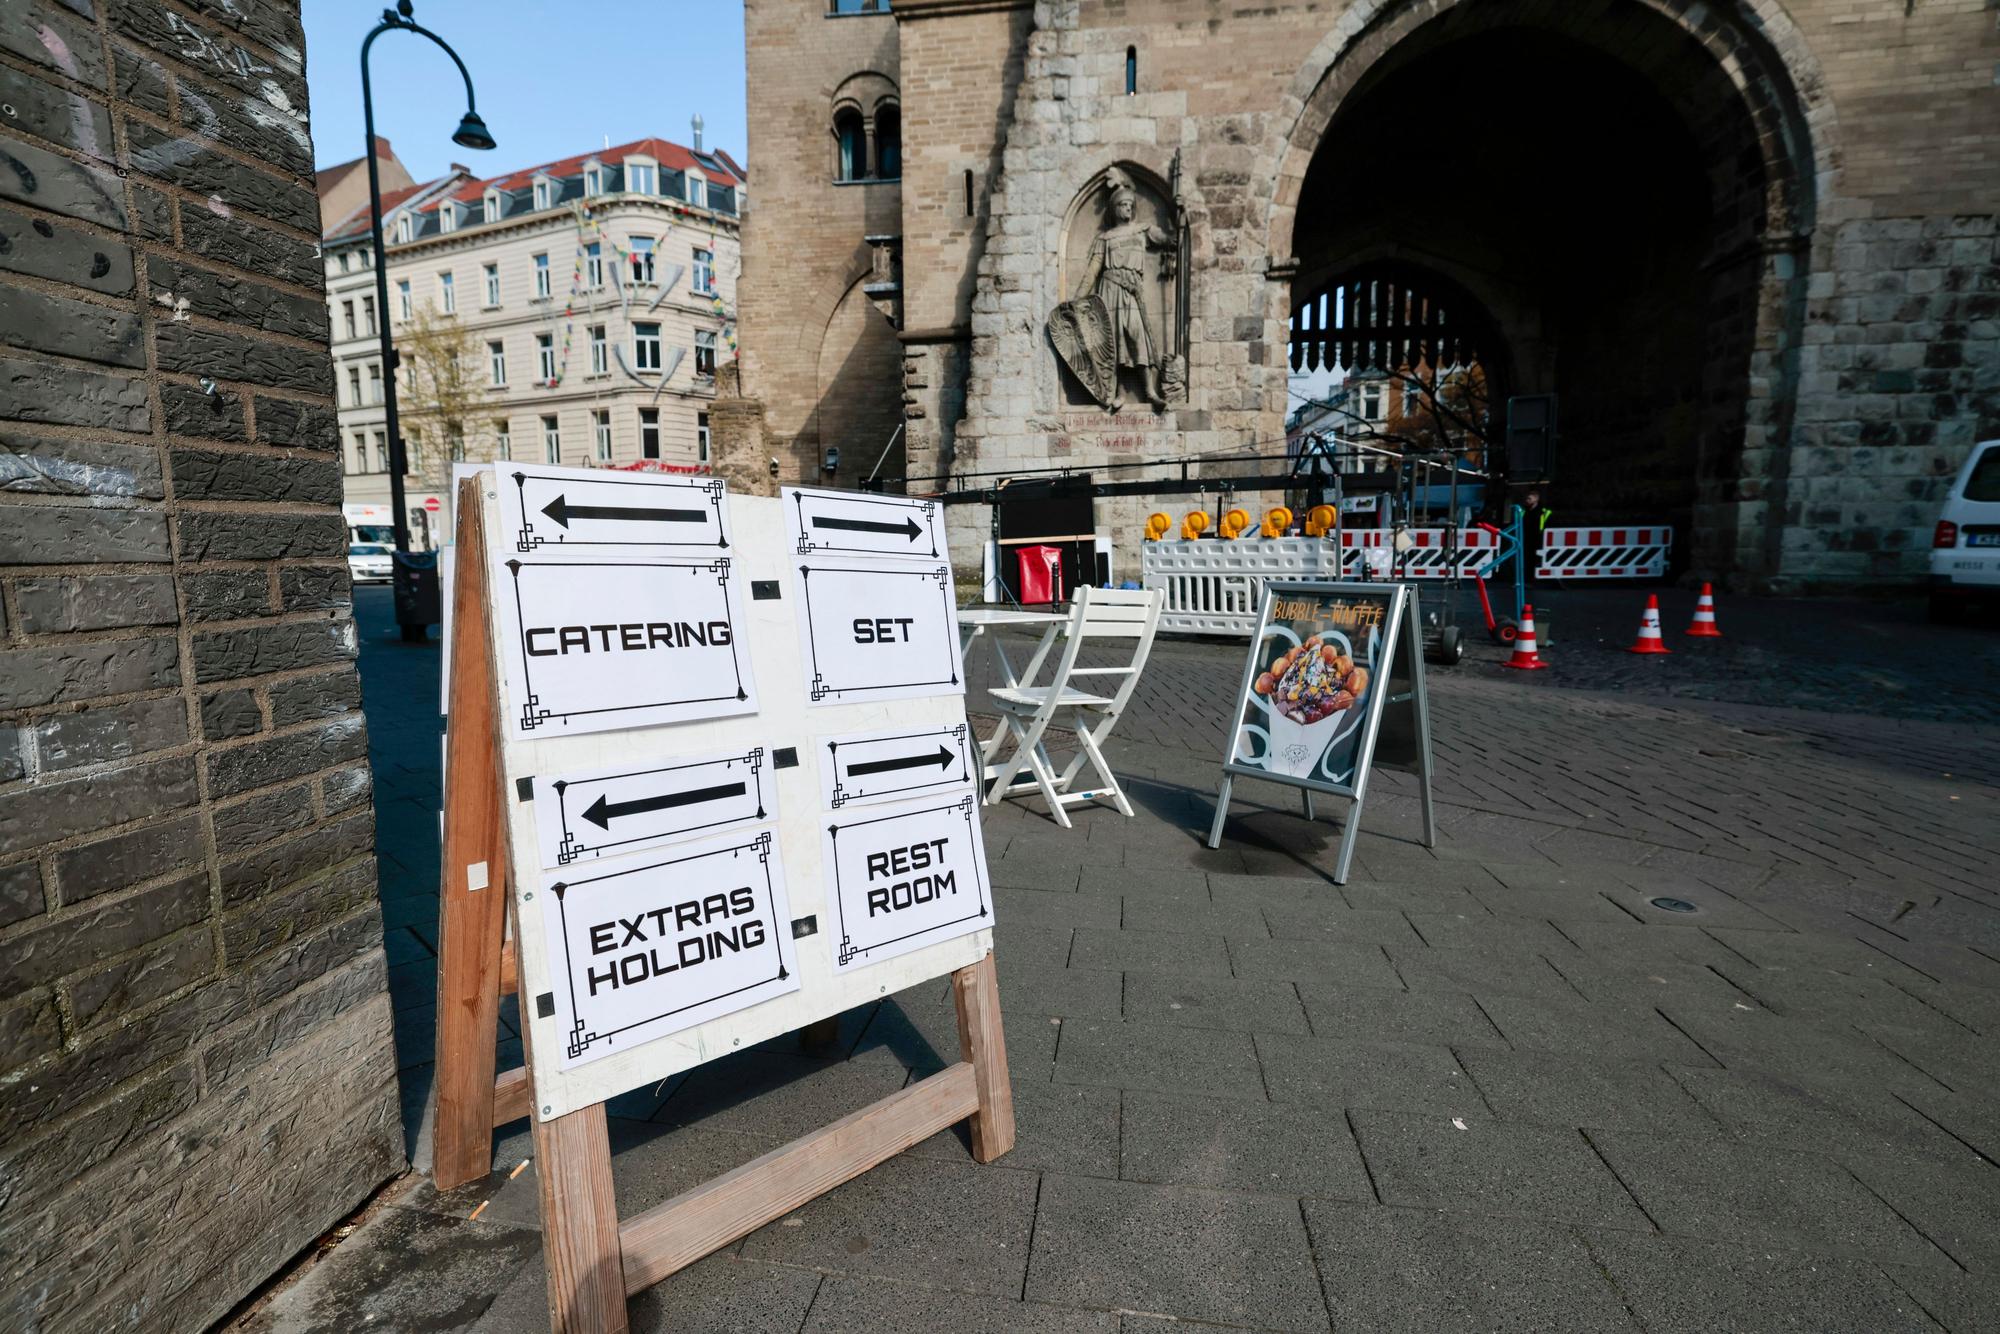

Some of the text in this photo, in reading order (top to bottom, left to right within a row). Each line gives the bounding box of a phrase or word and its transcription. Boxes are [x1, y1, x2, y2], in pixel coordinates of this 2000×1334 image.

[525, 621, 732, 657] CATERING
[853, 618, 914, 644] SET
[866, 837, 949, 881] REST
[867, 870, 957, 918] ROOM
[589, 886, 756, 956] EXTRAS
[587, 919, 765, 997] HOLDING
